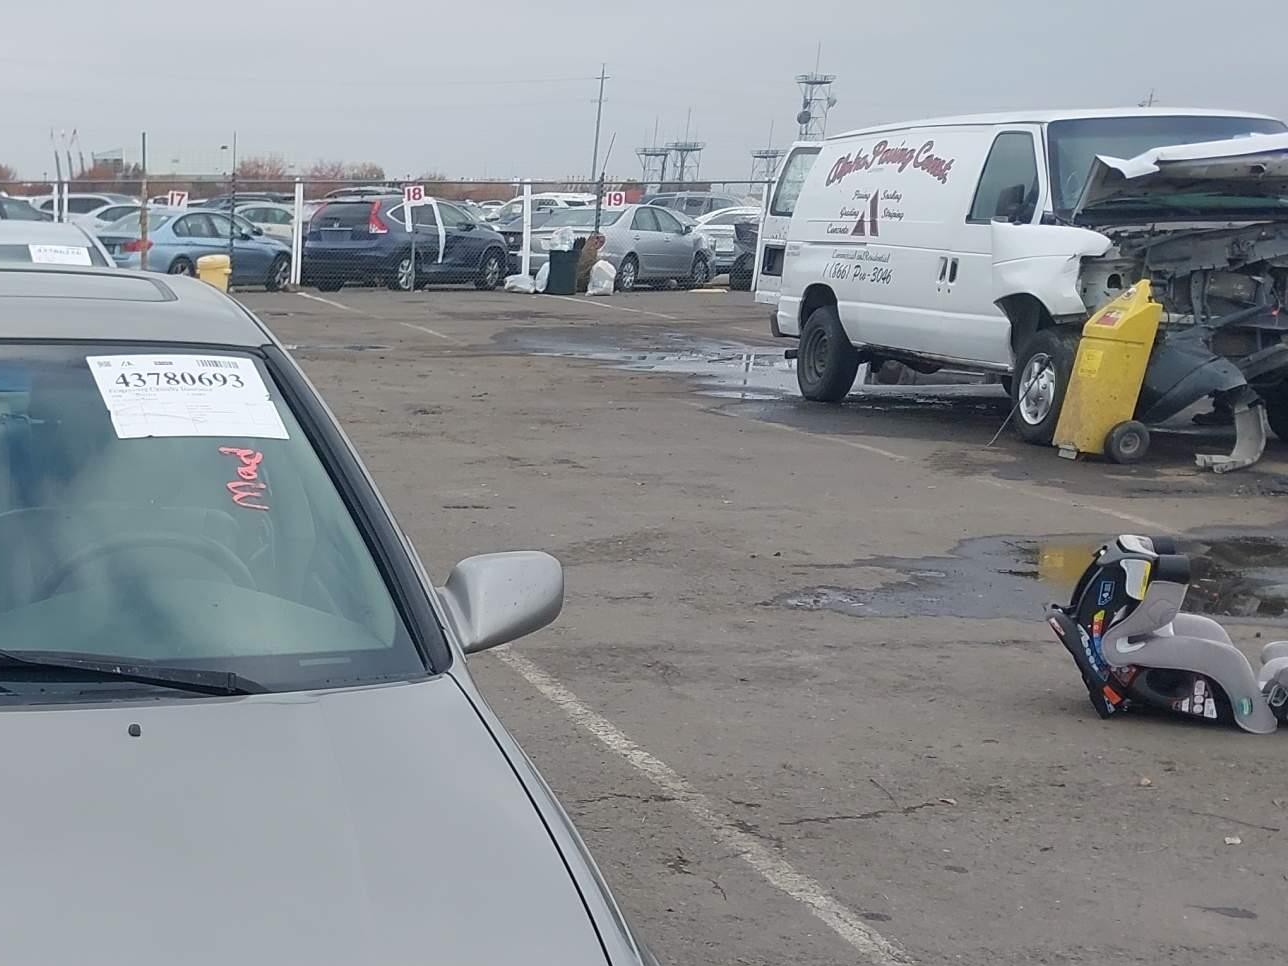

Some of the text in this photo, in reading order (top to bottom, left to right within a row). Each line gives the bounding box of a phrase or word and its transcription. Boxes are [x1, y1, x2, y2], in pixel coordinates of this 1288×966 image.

[825, 148, 871, 187] Alpha
[869, 140, 916, 173] Paving
[170, 192, 185, 206] 17
[406, 187, 422, 201] 18
[607, 192, 623, 206] 19
[115, 371, 245, 389] 43780693
